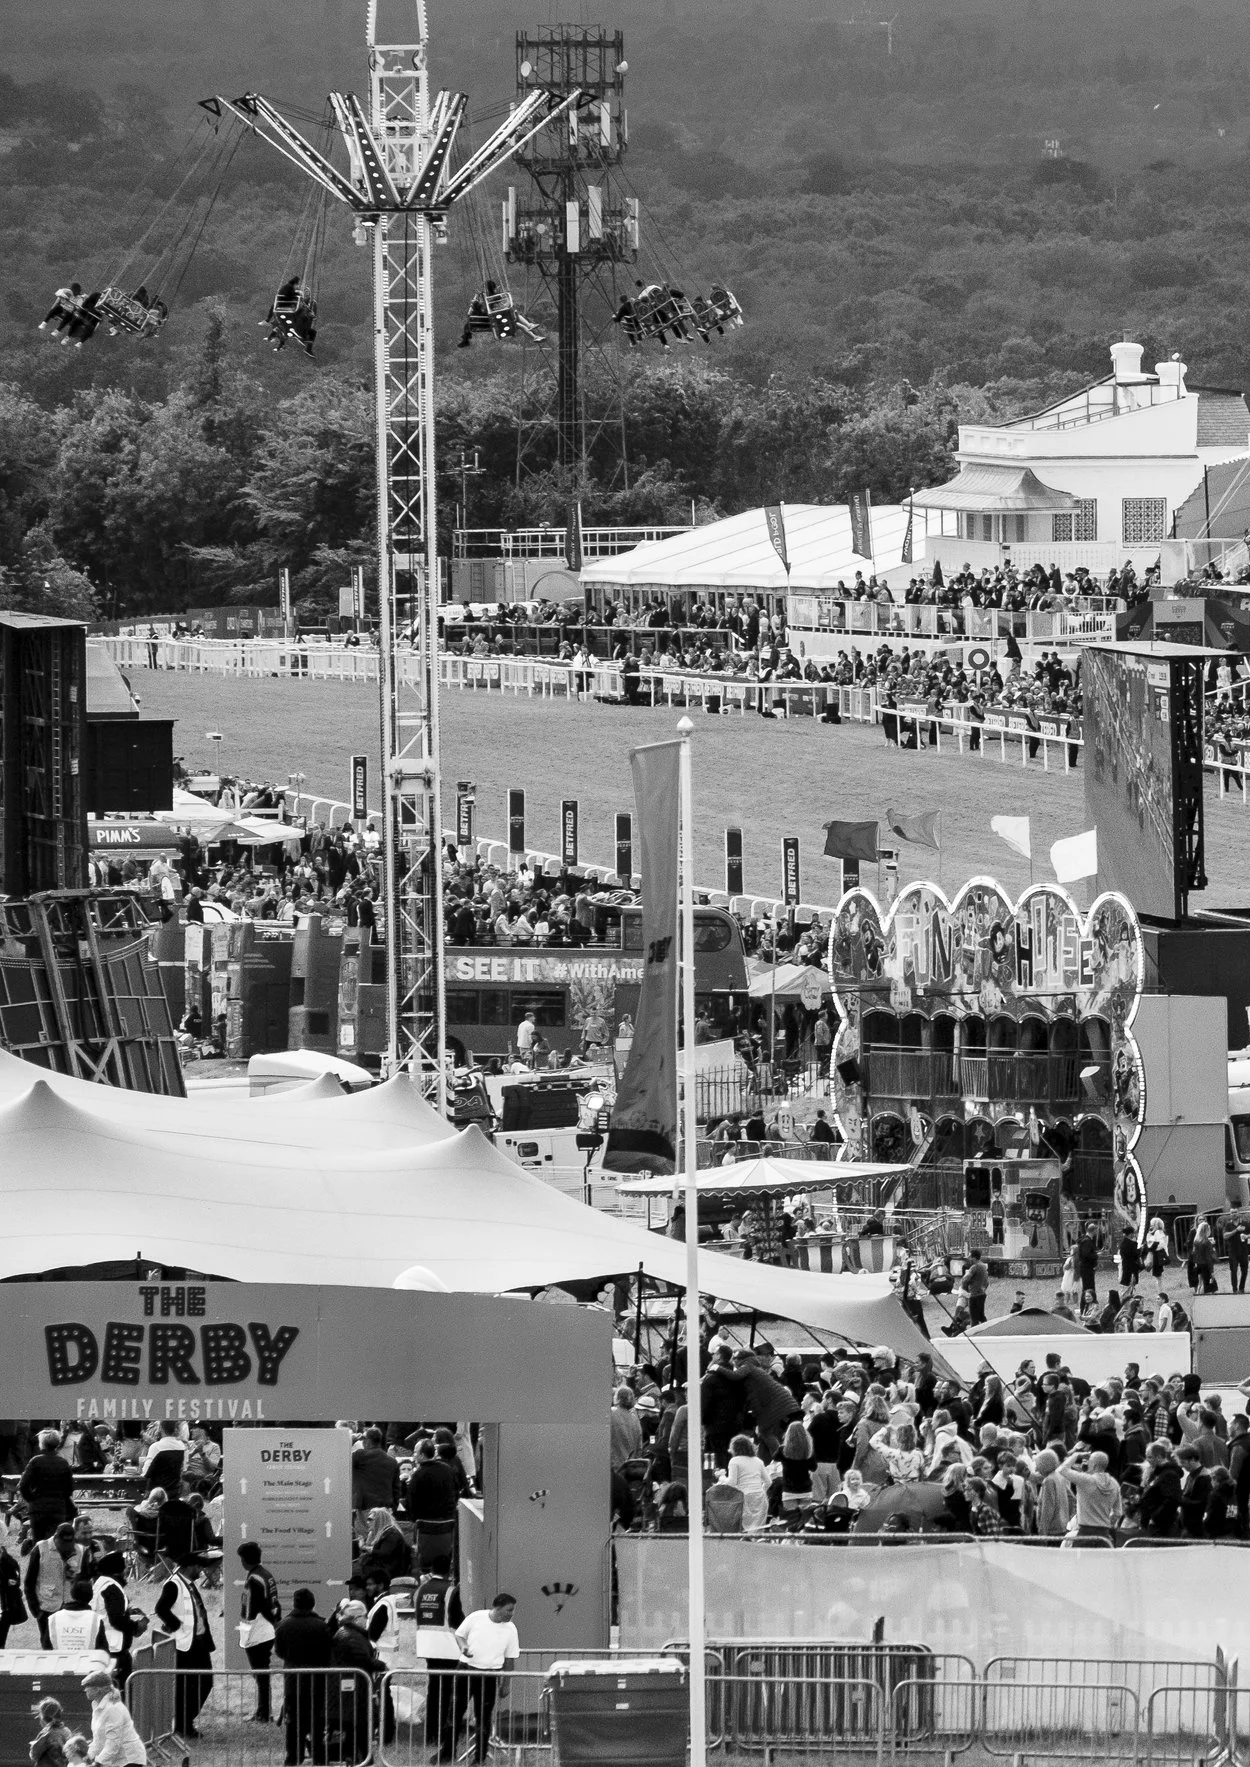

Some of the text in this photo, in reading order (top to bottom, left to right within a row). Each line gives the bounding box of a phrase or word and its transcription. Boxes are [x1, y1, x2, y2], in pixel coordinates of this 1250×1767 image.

[356, 766, 364, 810] BETFRED
[96, 828, 141, 843] PIMM'S
[565, 810, 574, 856] BETFRED
[787, 848, 797, 895] BETFRED
[456, 957, 508, 980] SEE
[513, 959, 540, 981] IT
[139, 1286, 206, 1317] THE
[45, 1321, 300, 1386] DERBY
[76, 1398, 265, 1419] FAMILY FESTIVAL
[260, 1450, 312, 1463] DERBY
[295, 1480, 312, 1488] Stage
[293, 1527, 315, 1535] Village
